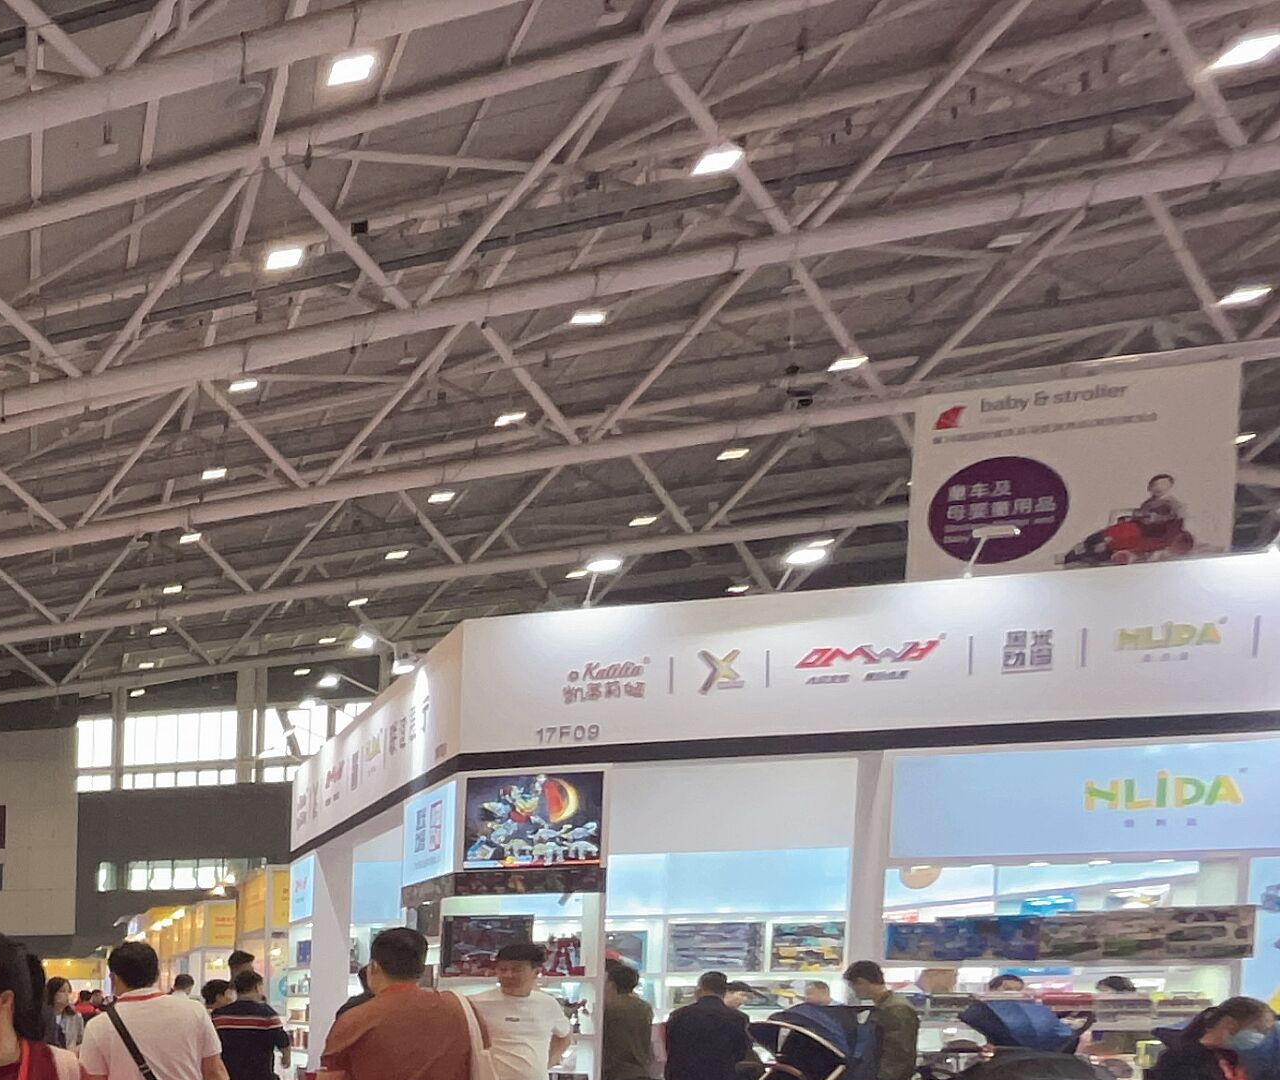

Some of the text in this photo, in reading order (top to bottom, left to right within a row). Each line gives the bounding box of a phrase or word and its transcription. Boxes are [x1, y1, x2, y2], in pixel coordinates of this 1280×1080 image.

[980, 394, 1030, 414] baby
[1053, 384, 1128, 406] stroller
[535, 724, 601, 745] 17F09
